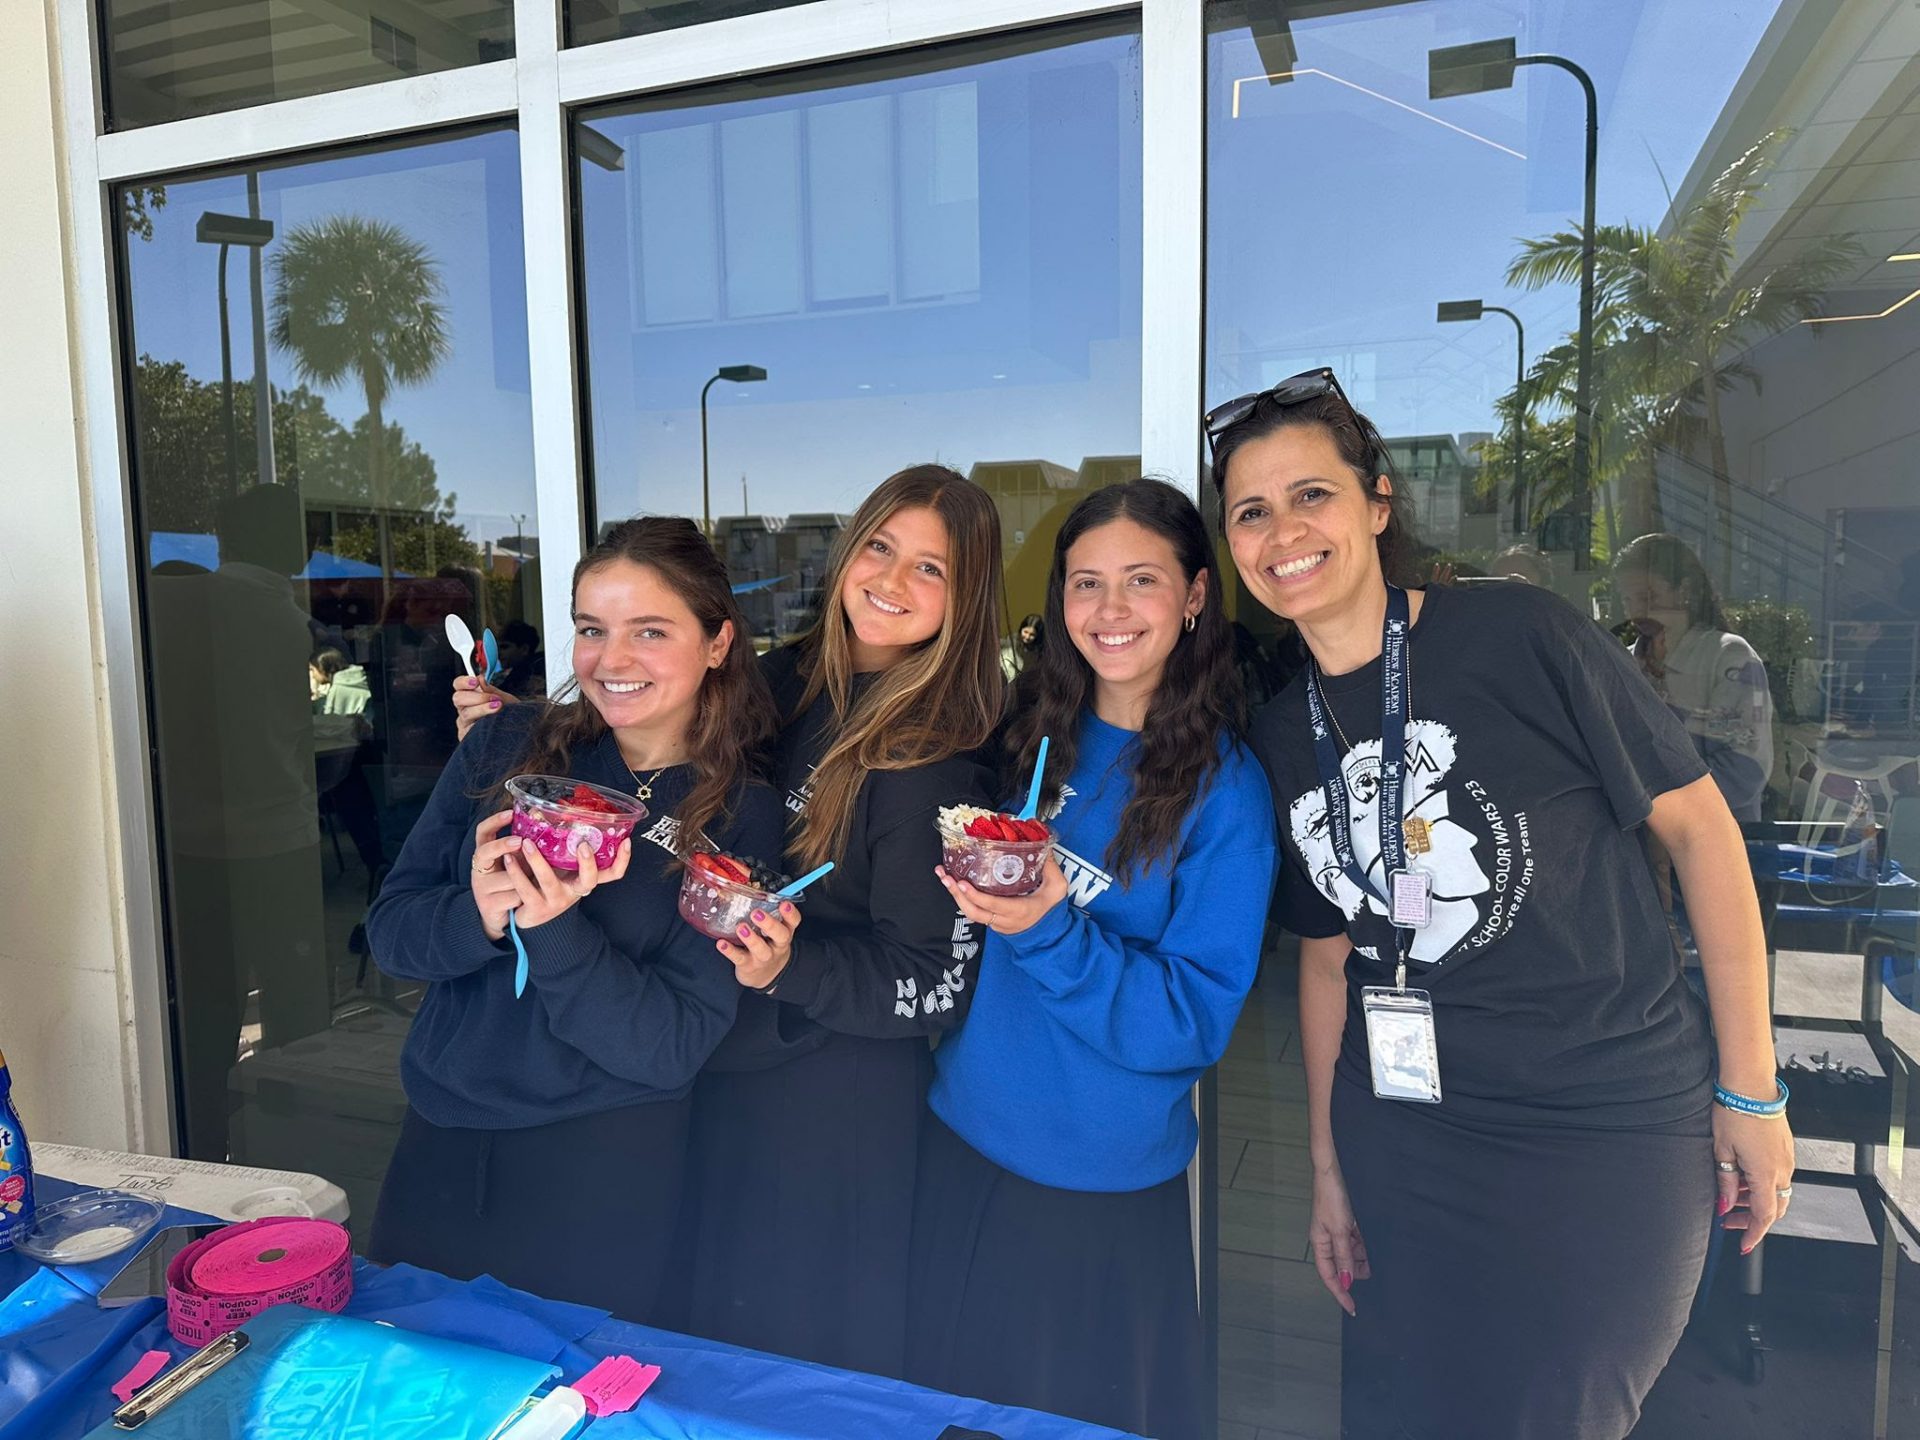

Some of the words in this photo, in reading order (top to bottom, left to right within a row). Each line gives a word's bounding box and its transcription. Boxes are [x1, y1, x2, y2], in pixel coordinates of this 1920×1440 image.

[1391, 636, 1403, 670] HEBREW
[1390, 671, 1402, 715] ACADEMY
[1387, 780, 1399, 817] HEBREW
[1464, 780, 1487, 801] '23
[1480, 802, 1511, 846] WARS
[1514, 811, 1532, 856] Team!
[1387, 818, 1399, 866] ACADEMY
[1495, 848, 1512, 893] COLOR
[1521, 858, 1534, 886] one
[1471, 896, 1503, 948] SCHOOL
[219, 1299, 258, 1309] COUPON
[277, 1282, 314, 1300] COUPON
[177, 1322, 203, 1339] TICKET
[226, 1311, 251, 1320] KEEP
